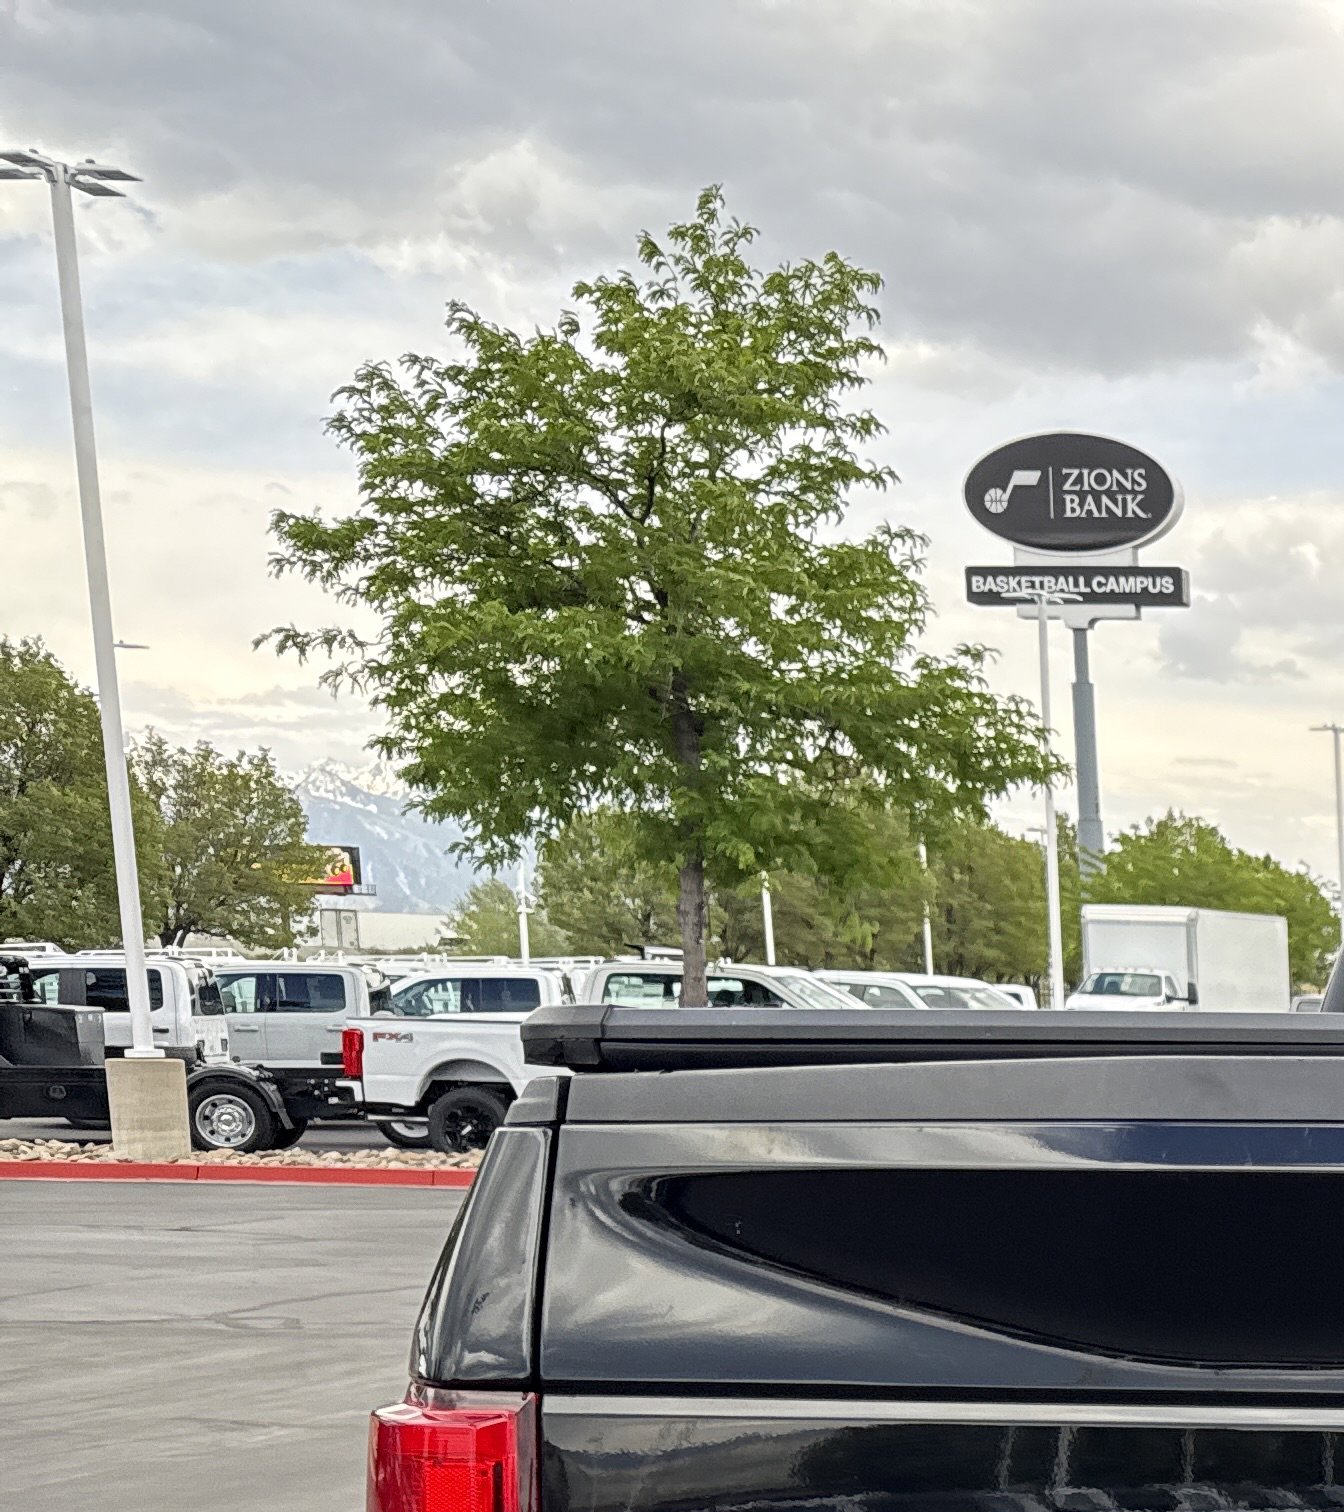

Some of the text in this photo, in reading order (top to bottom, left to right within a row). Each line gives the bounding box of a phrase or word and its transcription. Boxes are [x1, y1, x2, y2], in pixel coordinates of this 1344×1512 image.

[1061, 467, 1148, 492] ZIONS
[971, 575, 1175, 595] BASKETBALL CAMPUS
[372, 1031, 414, 1043] FX4
